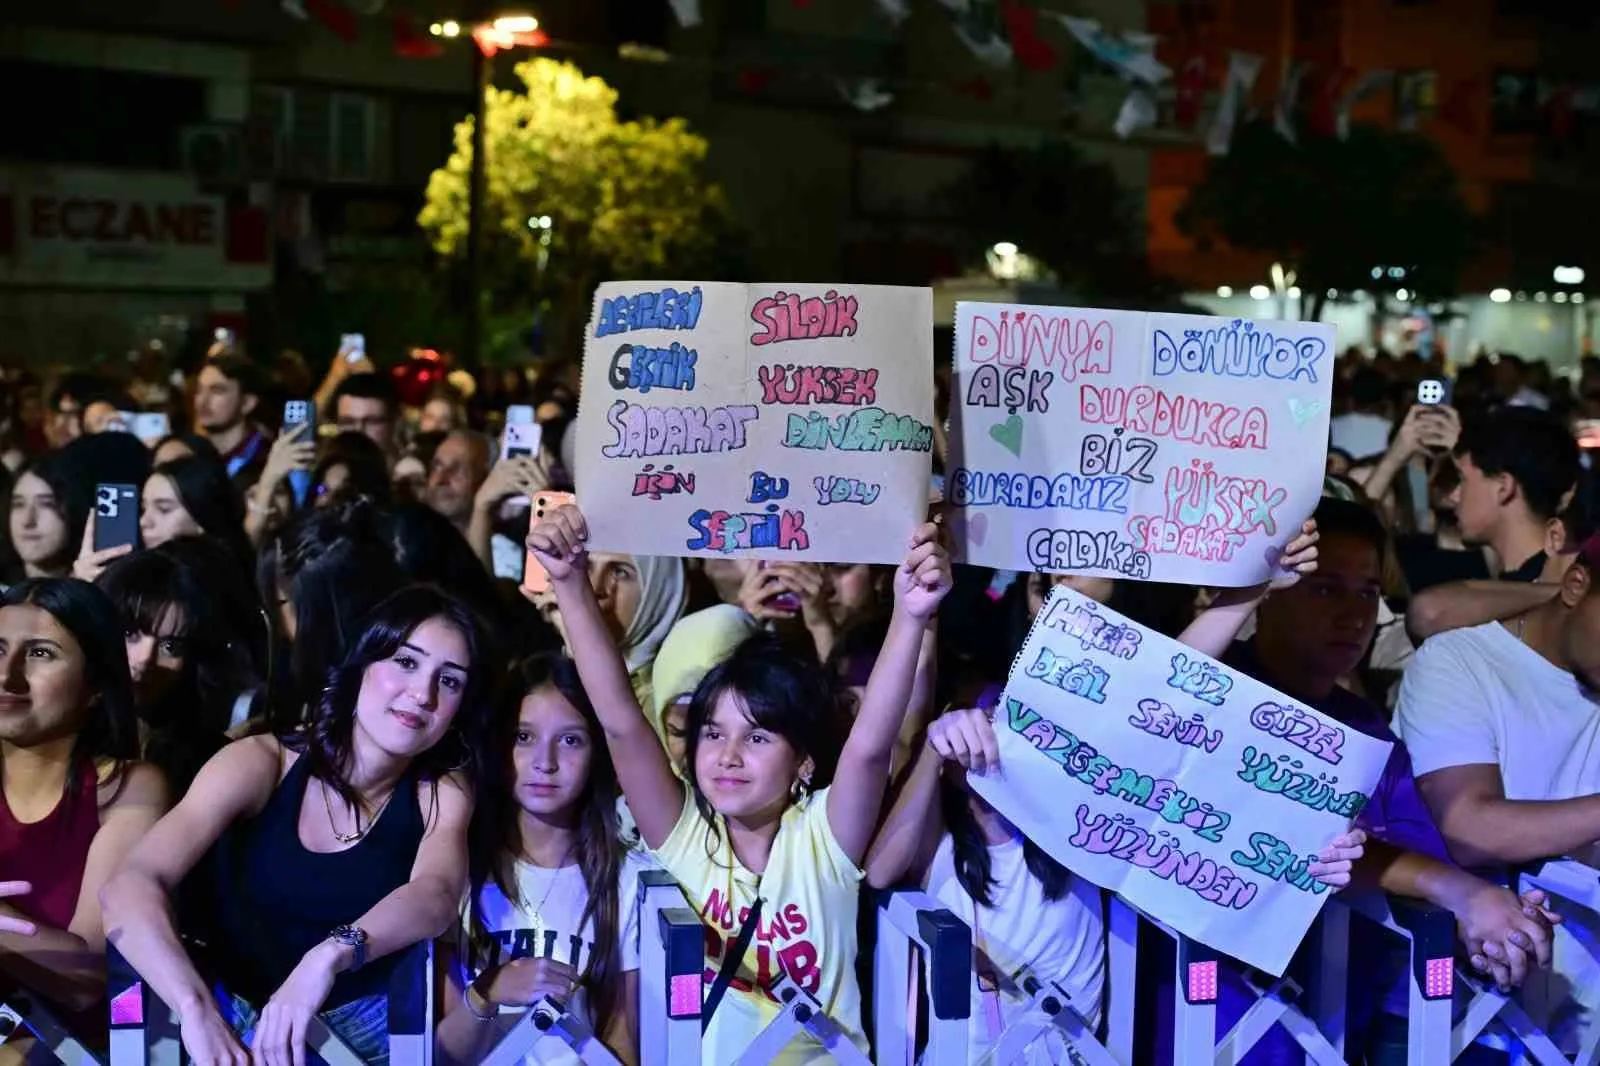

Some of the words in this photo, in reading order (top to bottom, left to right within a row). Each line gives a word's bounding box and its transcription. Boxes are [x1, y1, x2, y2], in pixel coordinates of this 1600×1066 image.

[31, 197, 214, 244] ECZANE
[750, 290, 859, 346] SİLDİK
[969, 311, 1114, 383] DÜNYA
[1152, 319, 1326, 384] DÖNÜYOR
[759, 364, 878, 405] YÜKSEK
[966, 363, 1054, 414] AŞK
[1079, 383, 1269, 450] DURDUKÇA
[602, 399, 759, 458] SADAKAT
[1080, 427, 1159, 484] BİZ
[746, 471, 790, 504] BU
[813, 475, 881, 506] YOLU
[950, 467, 1130, 514] BURADAYIZ
[1127, 514, 1246, 563] SADAKAT
[1166, 652, 1234, 706] YÜZ
[1249, 700, 1346, 766] GÜZEL
[1068, 804, 1258, 910] YÜZÜNDEN
